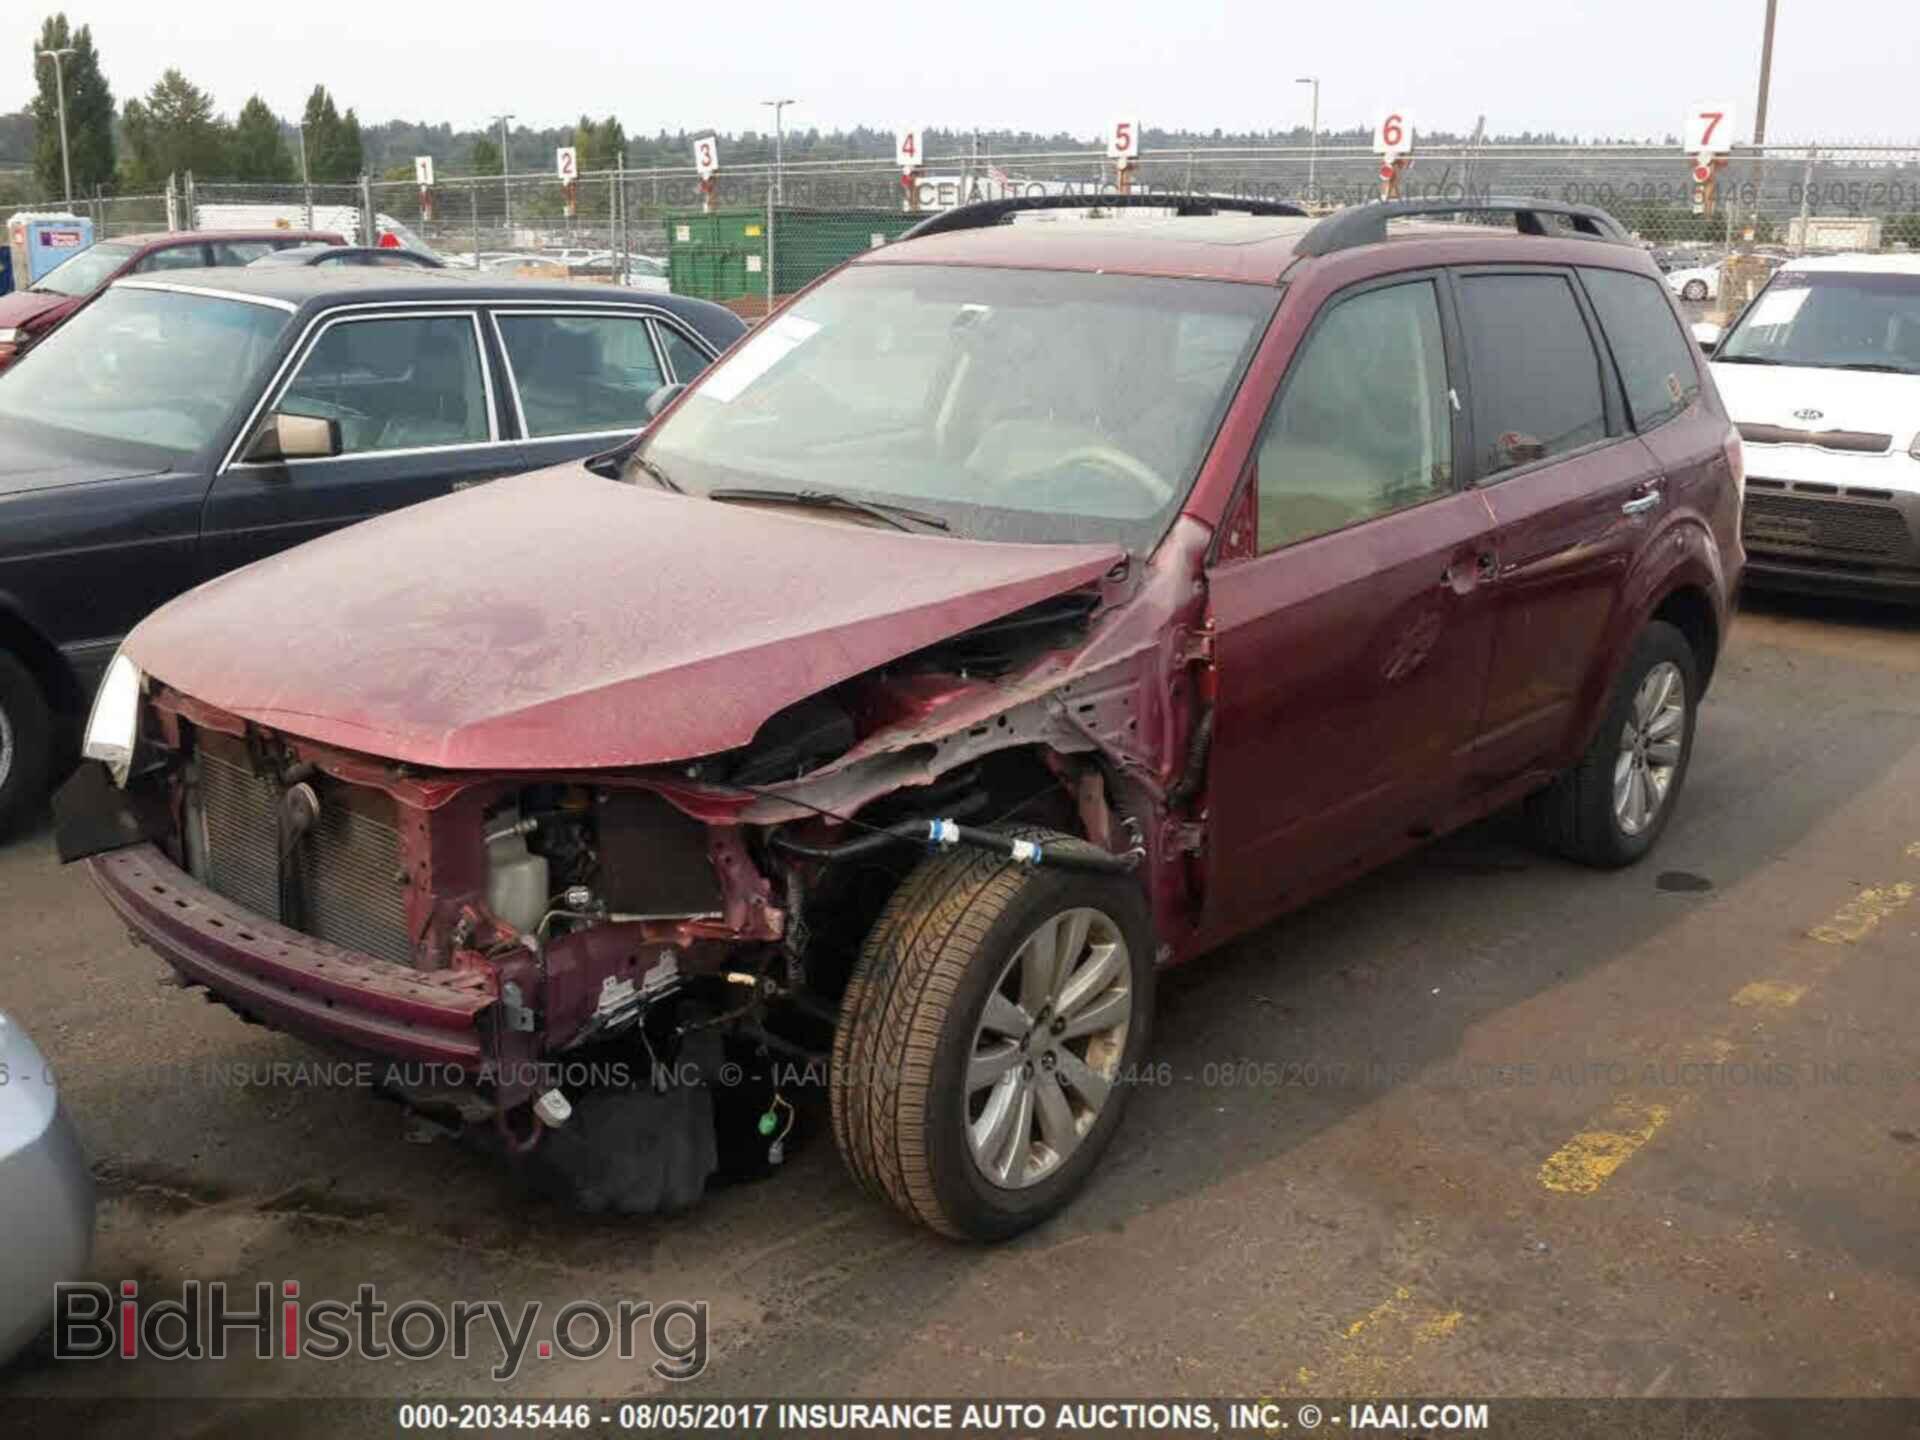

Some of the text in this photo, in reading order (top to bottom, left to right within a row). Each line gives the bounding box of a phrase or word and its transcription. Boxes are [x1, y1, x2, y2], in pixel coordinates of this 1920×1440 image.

[1115, 123, 1131, 151] 5
[1382, 114, 1402, 146] 6
[1699, 112, 1723, 146] 7
[700, 143, 712, 167] 3
[902, 133, 915, 157] 4
[562, 151, 573, 175] 2
